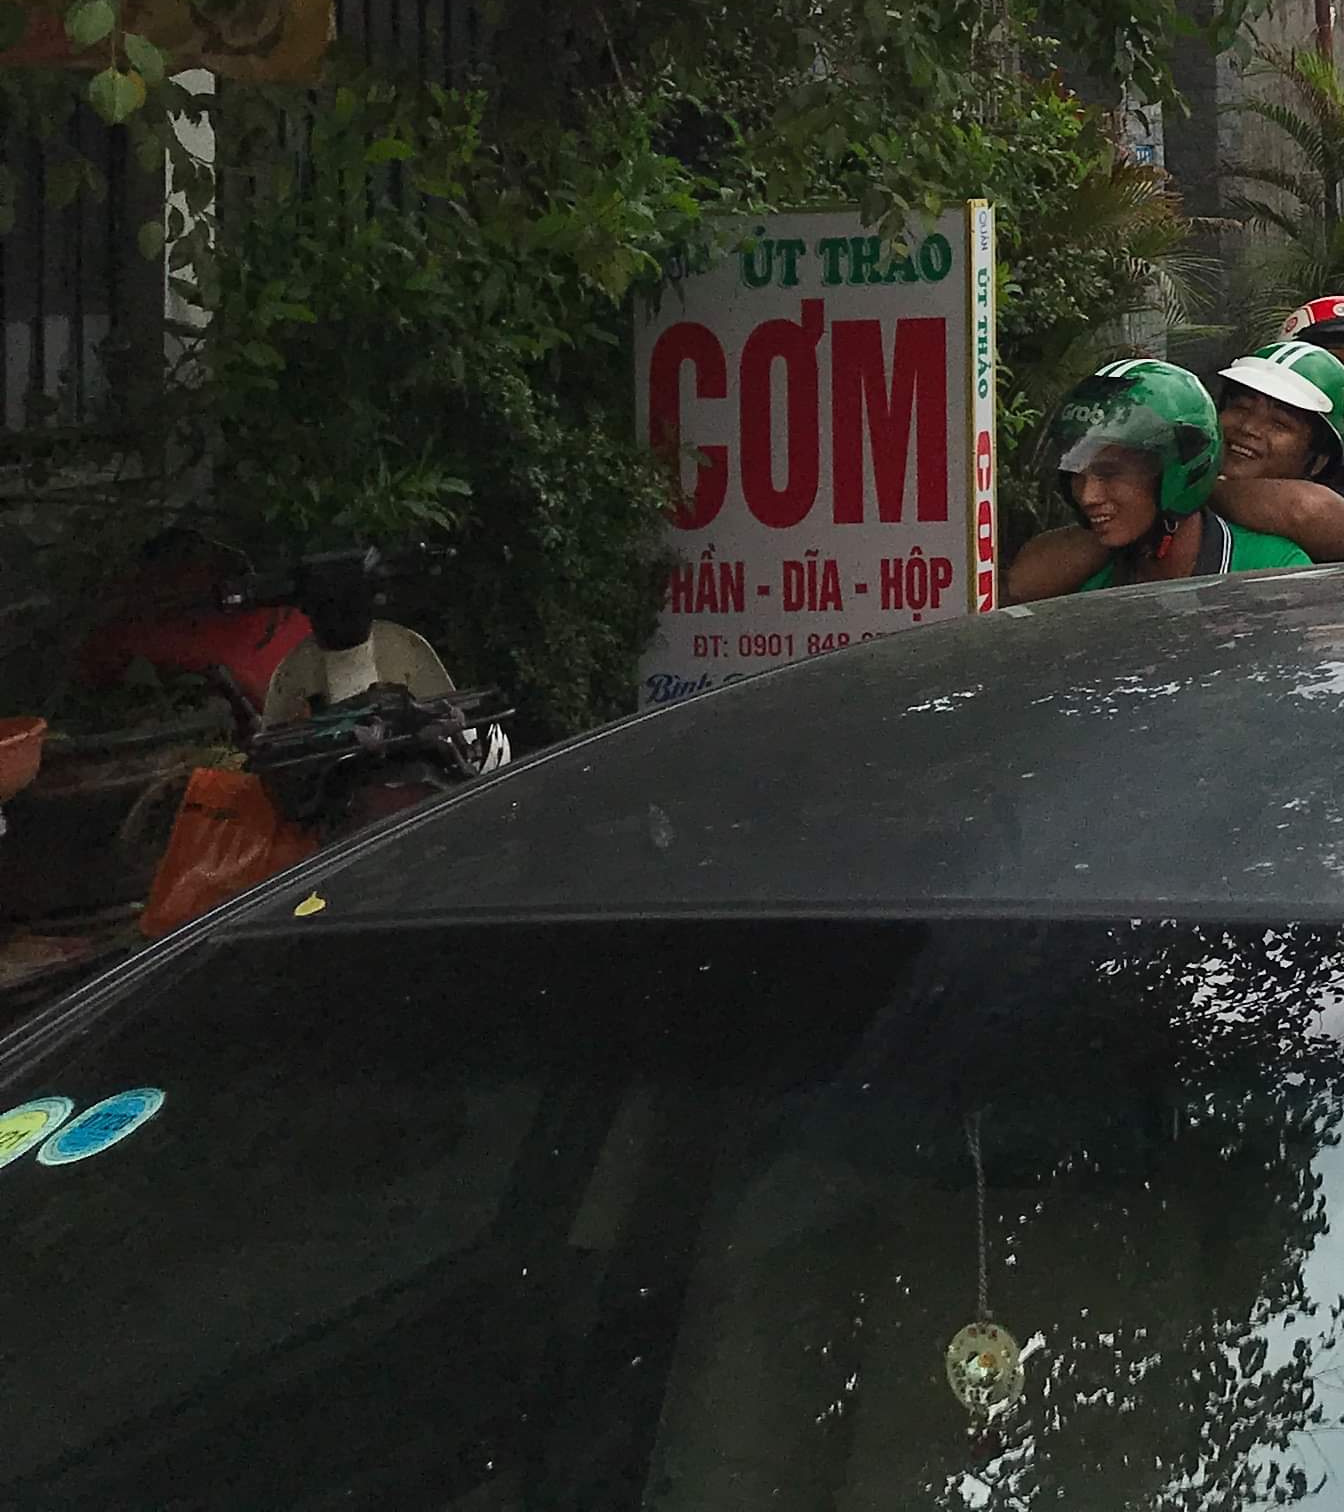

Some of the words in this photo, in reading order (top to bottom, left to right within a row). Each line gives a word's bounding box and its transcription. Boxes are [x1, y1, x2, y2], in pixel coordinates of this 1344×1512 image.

[976, 317, 990, 399] THẢO
[648, 298, 950, 531] CƠM
[666, 543, 745, 614] HẦN
[783, 550, 843, 612] DĨA
[880, 546, 954, 621] HỘP
[738, 633, 794, 658] 0901
